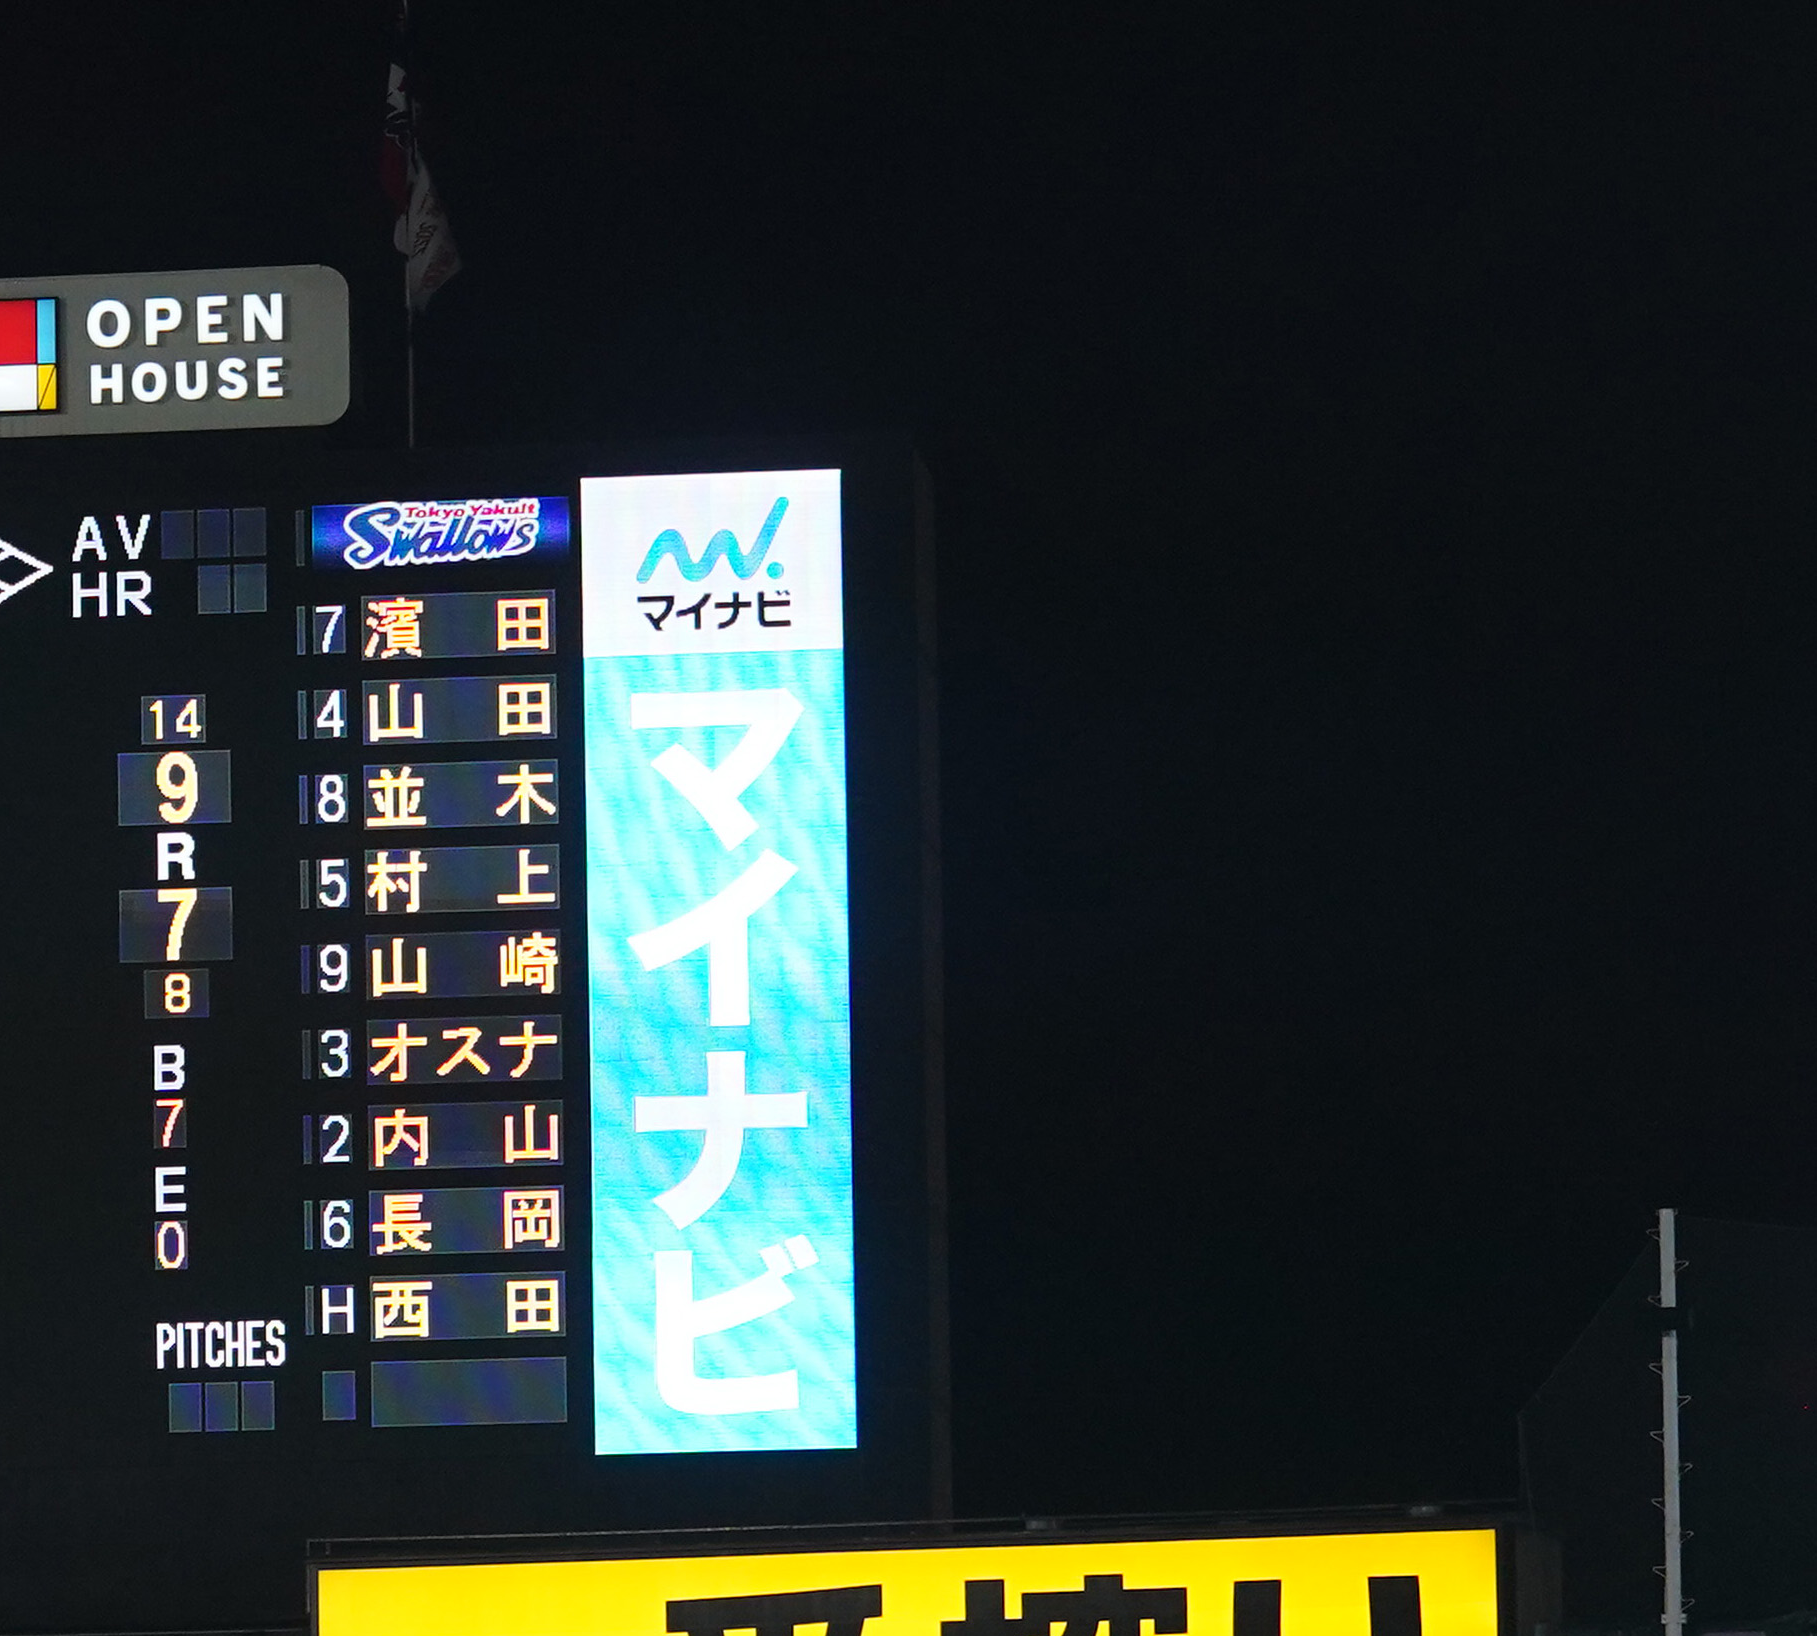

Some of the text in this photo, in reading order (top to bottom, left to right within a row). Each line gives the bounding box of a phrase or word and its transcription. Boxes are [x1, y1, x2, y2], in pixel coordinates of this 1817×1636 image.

[86, 293, 283, 349] OPEN
[89, 357, 283, 405] HOUSE
[344, 501, 538, 568] Swallows
[404, 502, 537, 519] Tokyo Yakult
[73, 515, 150, 561] AV
[73, 571, 151, 617] HR
[636, 590, 792, 632] マイナビ
[316, 606, 342, 652] 7
[150, 699, 201, 739] 14
[317, 683, 550, 741] 4 山田
[157, 751, 198, 823] 9
[318, 764, 556, 827] 8 並木
[158, 833, 195, 880] R
[320, 849, 555, 912] 5 村上
[158, 888, 197, 961] 7
[320, 945, 347, 992] 9
[165, 973, 190, 1013] 8
[154, 1045, 184, 1090] B
[322, 1021, 557, 1081] 3 オスナ
[628, 688, 819, 1415] マイナビ
[157, 1099, 183, 1147] 7
[323, 1105, 558, 1167] 2 内山
[156, 1167, 186, 1212] E
[158, 1221, 184, 1268] 0
[324, 1190, 559, 1254] 6 長岡
[322, 1280, 559, 1338] H 西田
[157, 1320, 285, 1369] PITCHES
